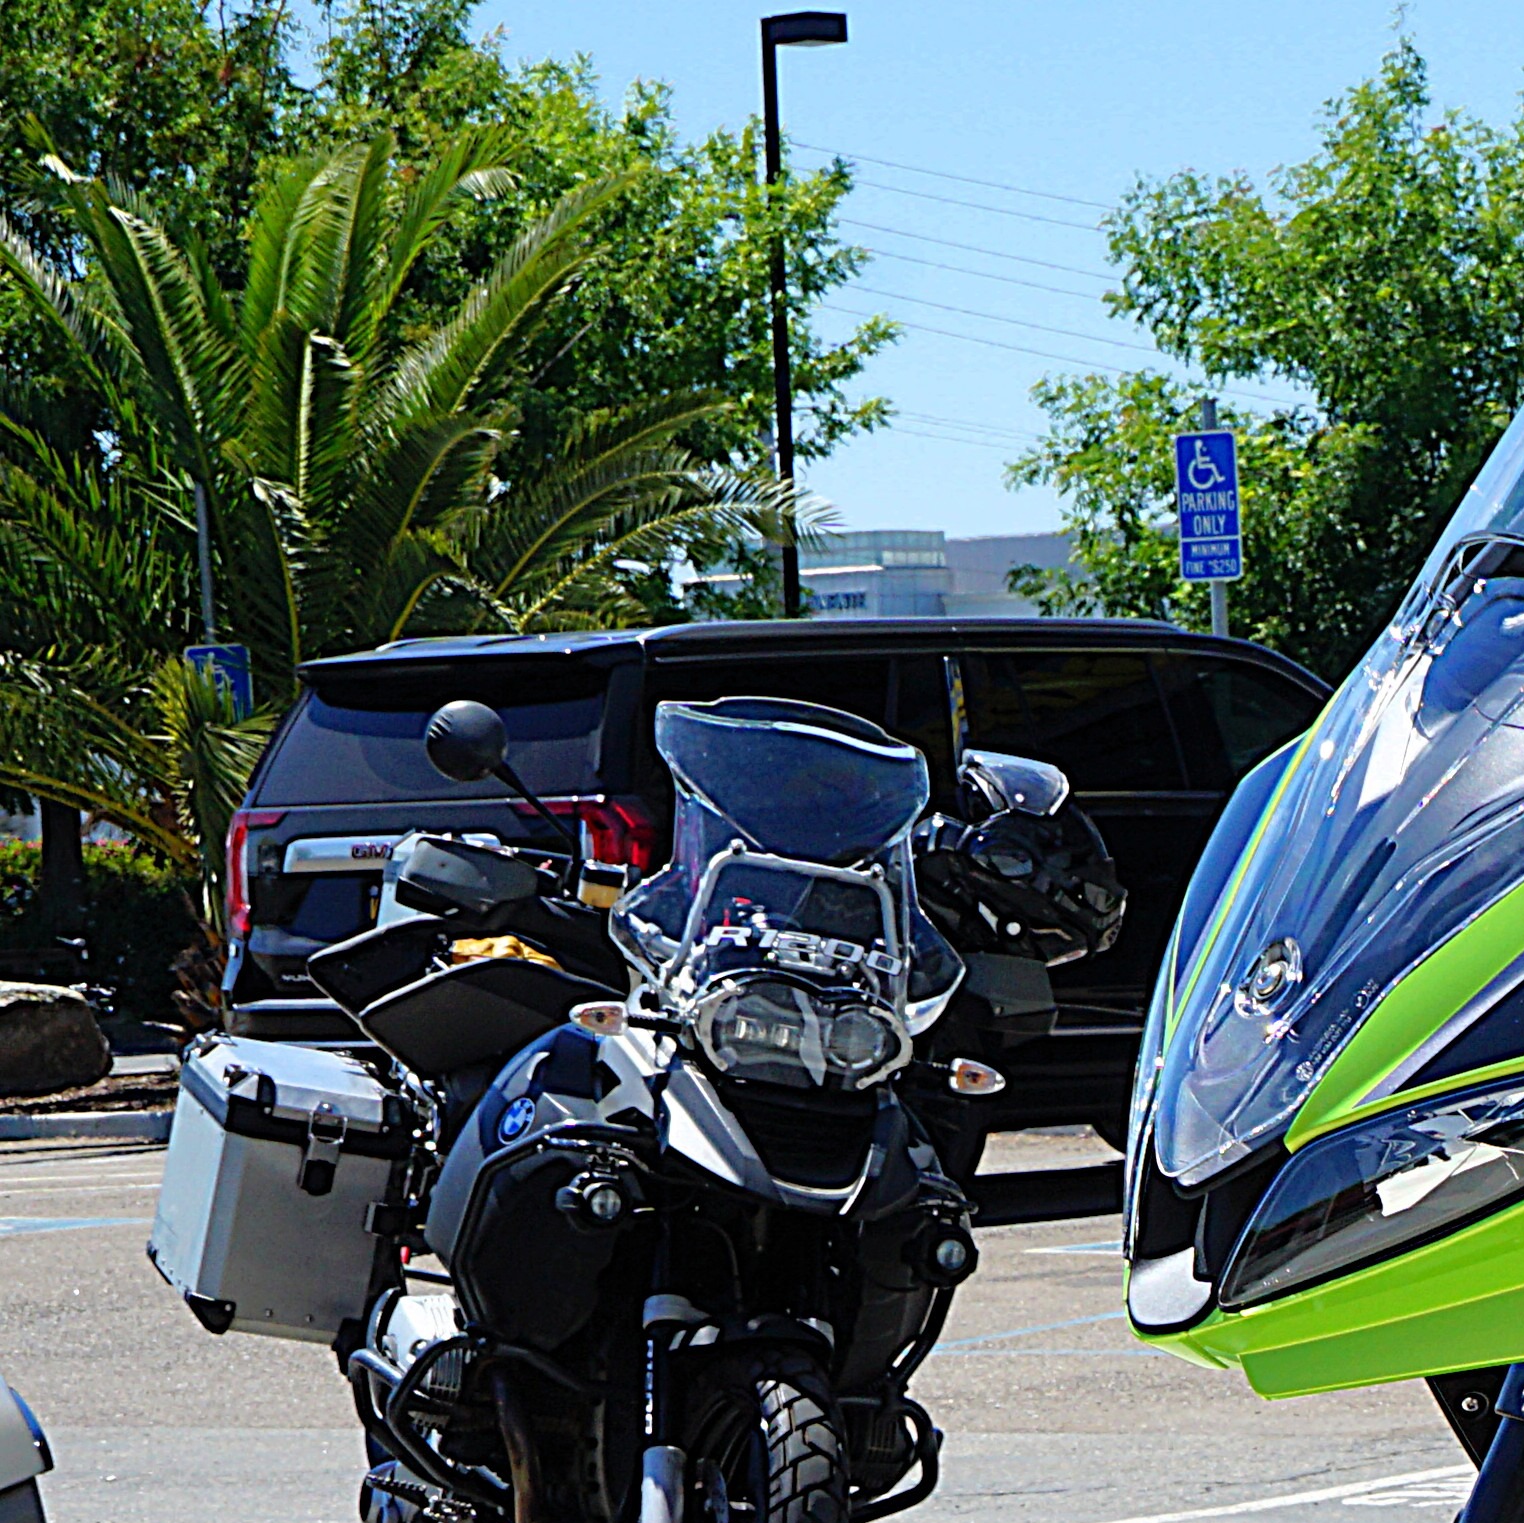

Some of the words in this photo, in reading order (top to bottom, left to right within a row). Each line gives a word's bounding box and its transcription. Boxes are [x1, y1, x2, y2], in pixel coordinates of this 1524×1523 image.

[1181, 490, 1235, 513] PARKING
[1193, 514, 1226, 536] ONLY
[1191, 543, 1230, 558] MINIMUM
[1185, 560, 1205, 575] FINE
[1212, 559, 1237, 574] $250
[705, 926, 902, 976] R1200
